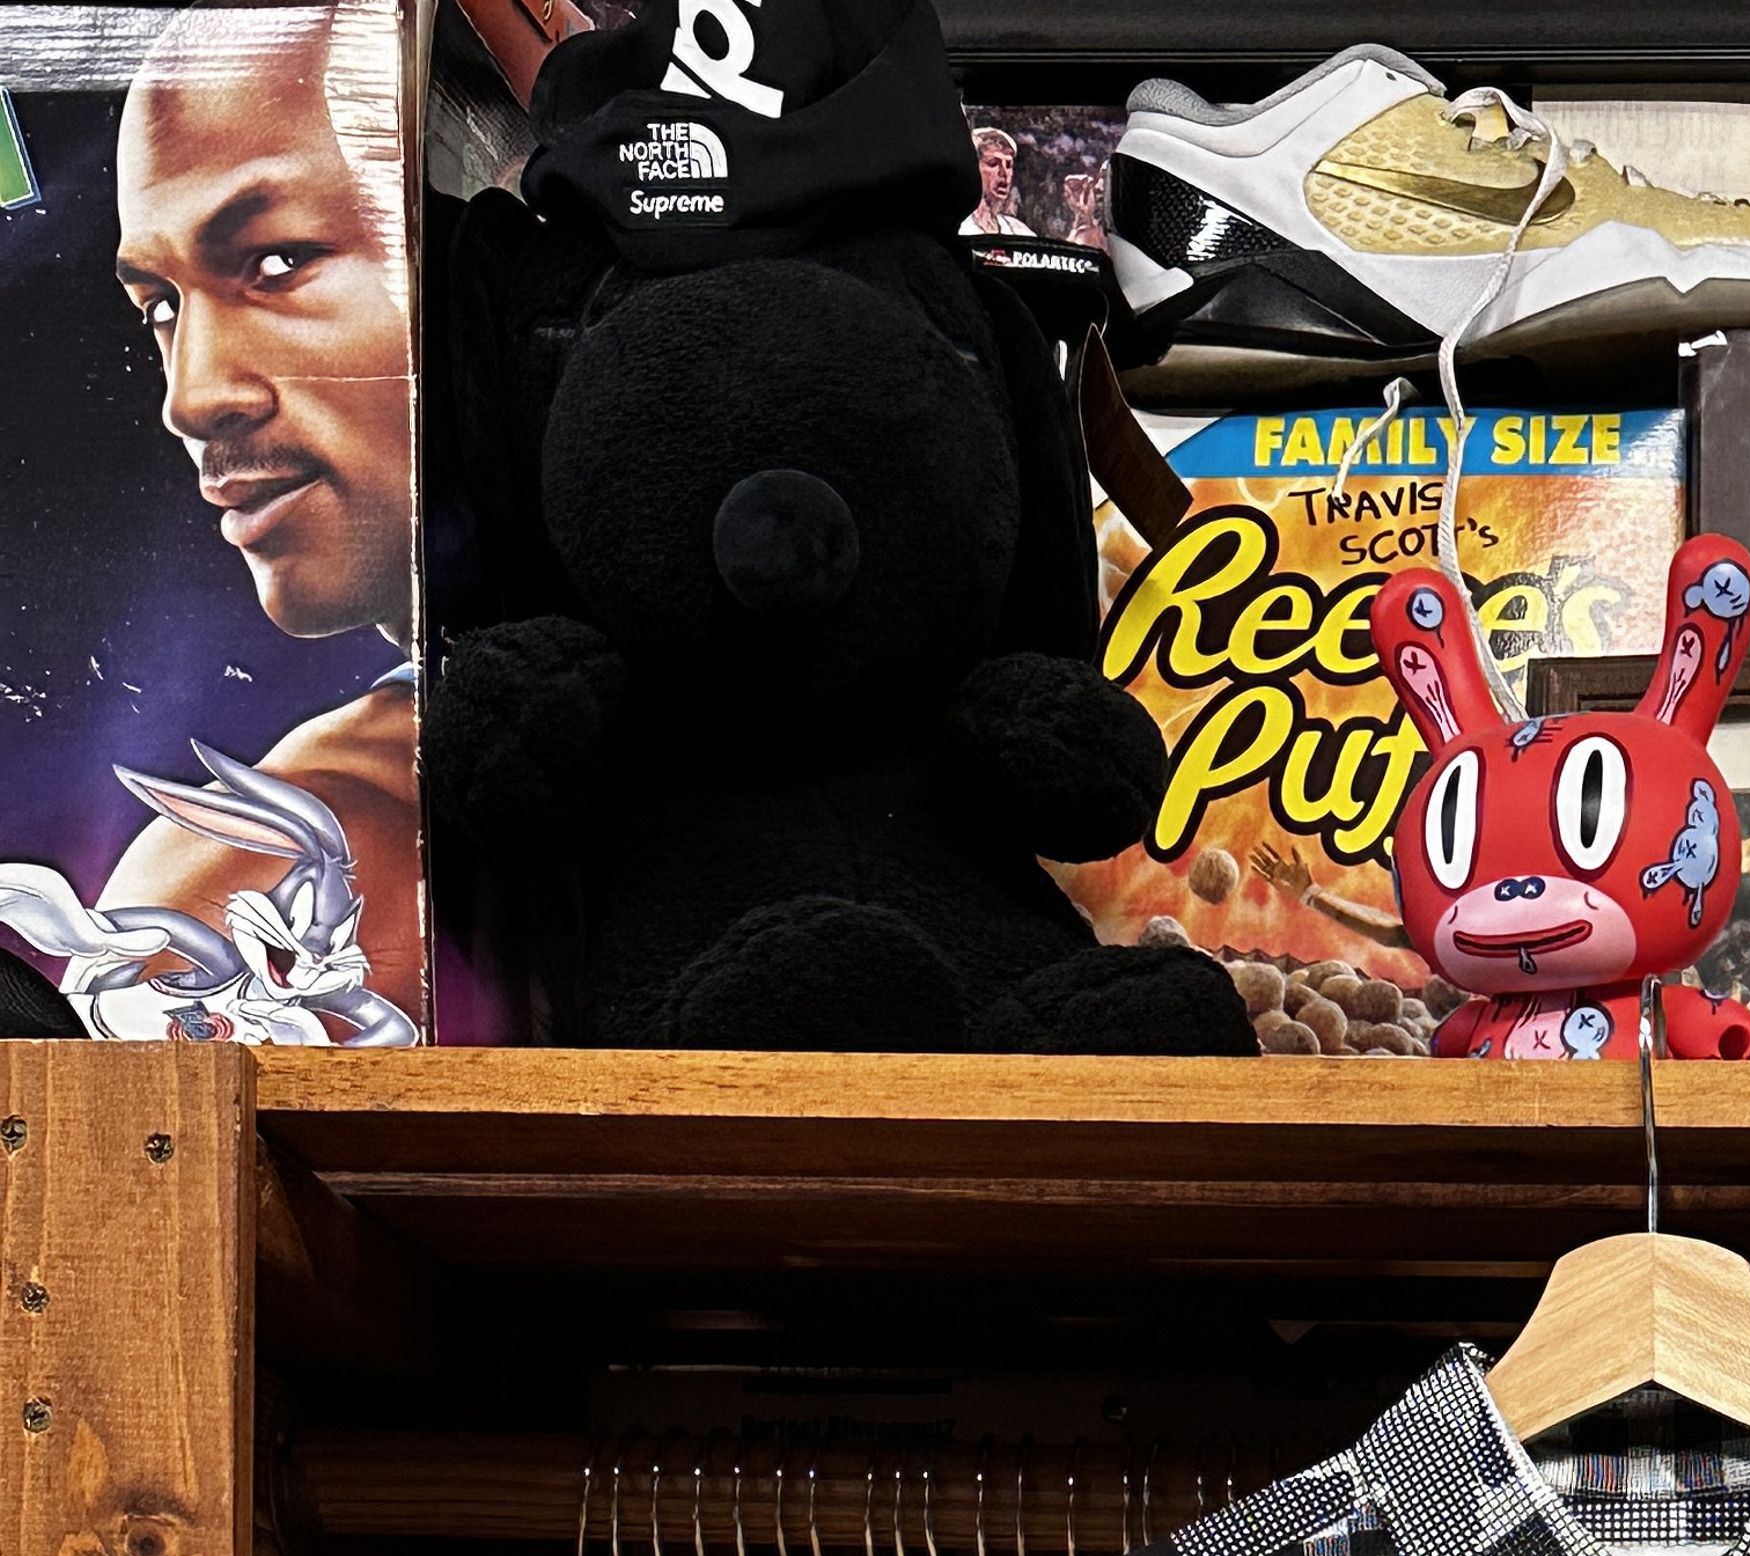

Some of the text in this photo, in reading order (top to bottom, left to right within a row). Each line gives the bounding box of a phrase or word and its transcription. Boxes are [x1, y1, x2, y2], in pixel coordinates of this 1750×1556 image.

[647, 122, 690, 141] THE
[619, 142, 689, 162] NORTH
[638, 161, 691, 181] FACE
[629, 190, 725, 220] Supreme
[1254, 414, 1621, 467] FAMILY SIZE
[1287, 481, 1444, 526] TRAVIS
[1339, 517, 1499, 565] SCOT's
